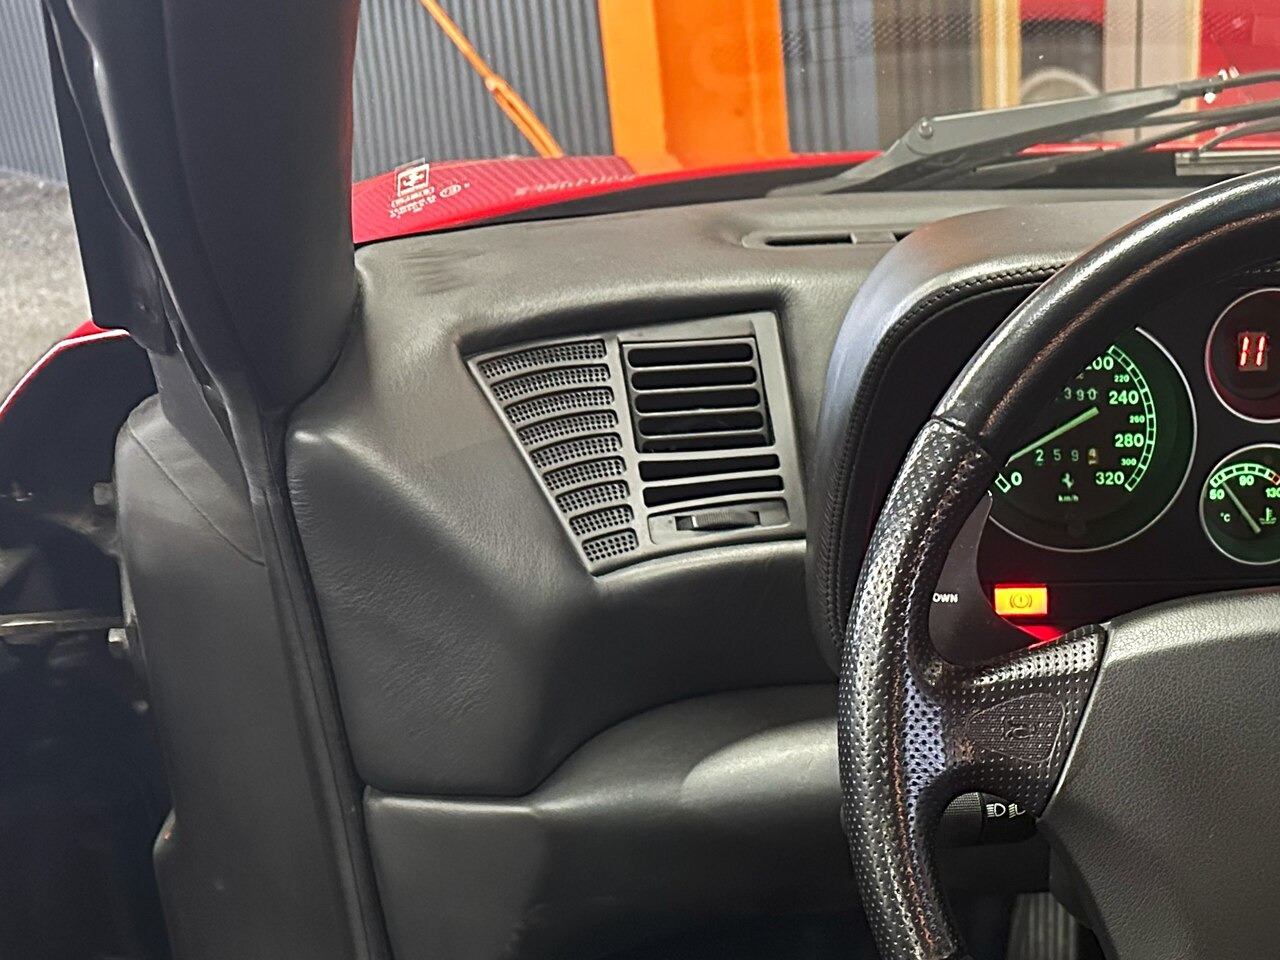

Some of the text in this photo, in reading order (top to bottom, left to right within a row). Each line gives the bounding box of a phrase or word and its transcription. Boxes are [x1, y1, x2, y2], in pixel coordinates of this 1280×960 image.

[1085, 356, 1115, 370] 00
[1114, 374, 1130, 383] 220
[1109, 390, 1139, 405] 240
[1114, 433, 1144, 447] 280
[1120, 457, 1137, 466] 300
[1011, 472, 1023, 486] 0
[1095, 471, 1125, 485] 320
[932, 592, 959, 603] OWN
